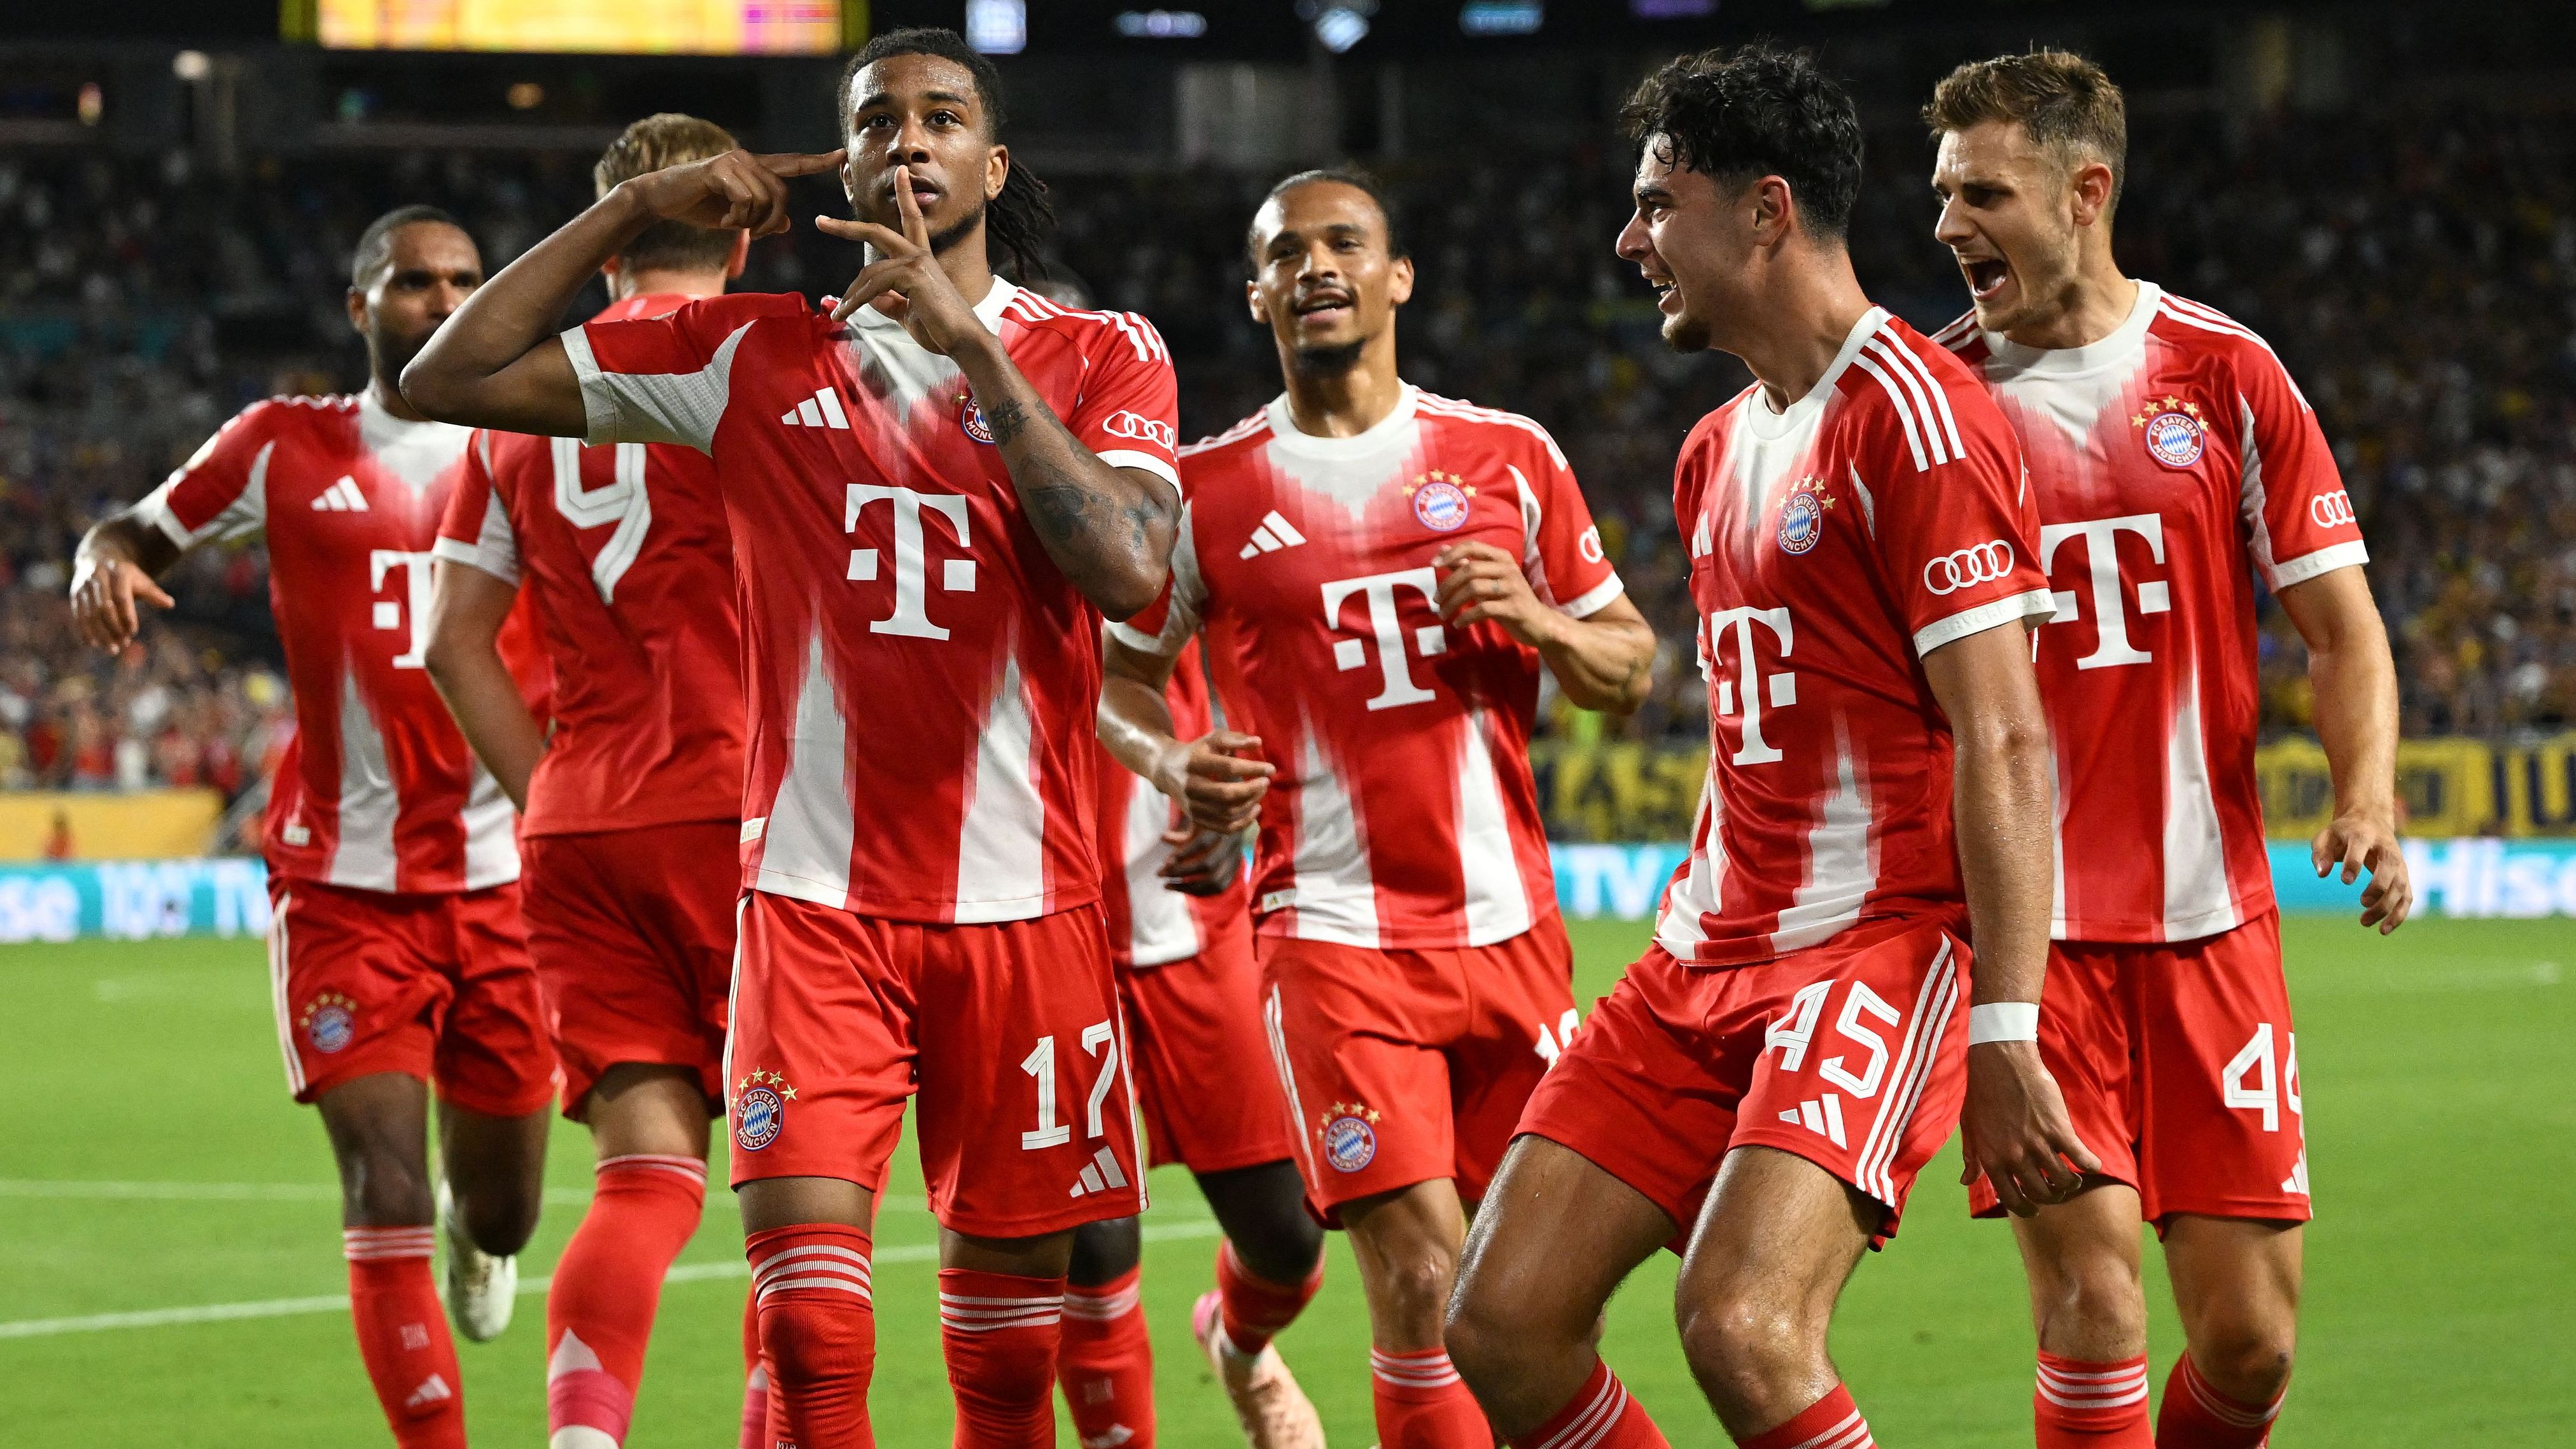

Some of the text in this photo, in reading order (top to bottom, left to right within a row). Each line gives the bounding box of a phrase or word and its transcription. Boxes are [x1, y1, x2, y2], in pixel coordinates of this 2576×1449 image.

[2160, 416, 2199, 437] BAYERN
[550, 436, 652, 606] 9
[845, 483, 971, 641] T
[1794, 496, 1818, 519] BAYERN
[1320, 566, 1441, 712] T
[2040, 512, 2166, 671] T
[1711, 606, 1794, 766] T
[1568, 844, 1663, 919] TV
[738, 1091, 779, 1118] FC BAYERN
[1020, 1018, 1118, 1151] 17
[1765, 979, 1901, 1099] 45
